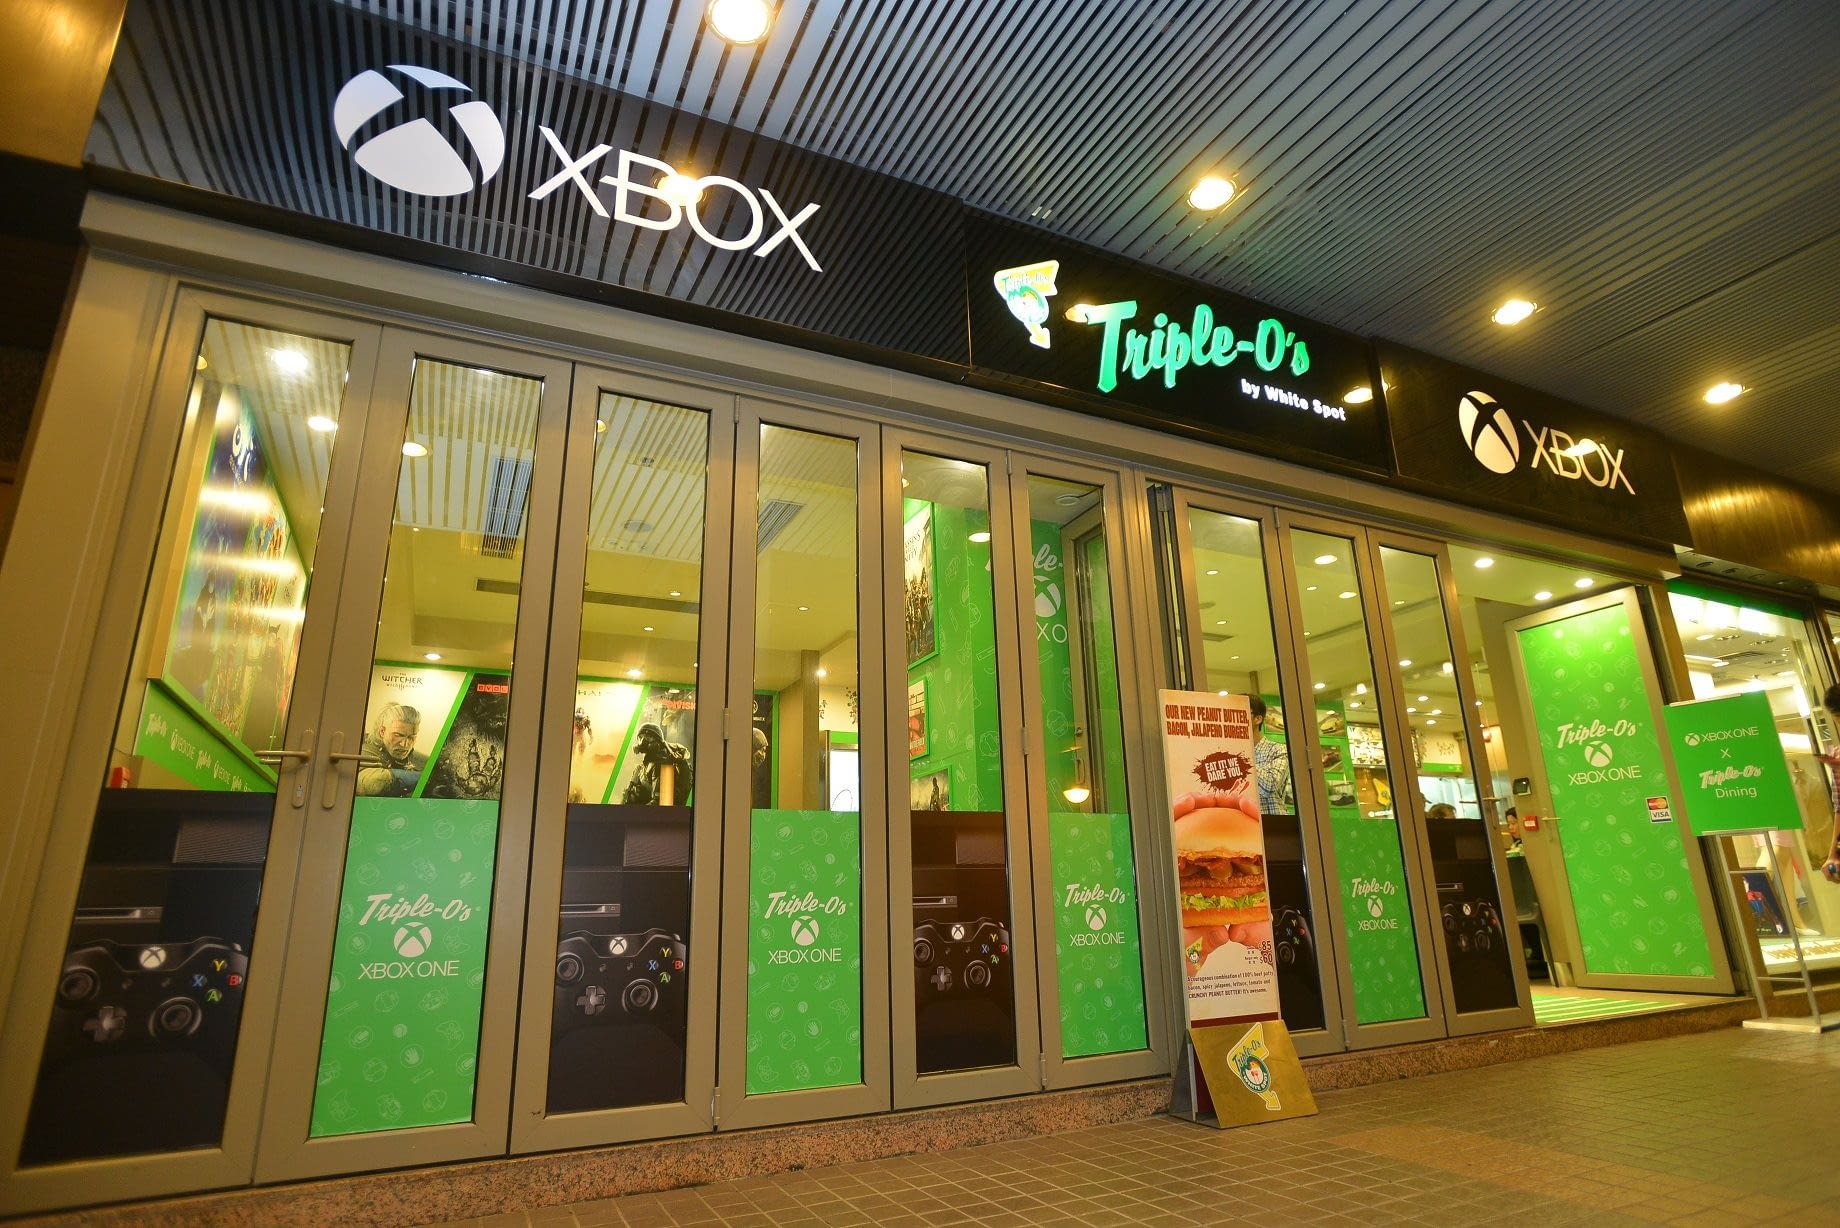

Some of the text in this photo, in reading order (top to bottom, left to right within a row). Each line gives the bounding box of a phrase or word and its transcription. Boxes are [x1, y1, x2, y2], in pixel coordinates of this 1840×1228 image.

[528, 124, 824, 273] XBOX
[1087, 301, 1310, 393] Triple-O's
[1241, 378, 1346, 421] by White Spot
[1522, 420, 1636, 495] XBOX
[381, 675, 423, 685] WITCHER
[1165, 704, 1179, 719] OUR
[1180, 705, 1195, 720] NEW
[1197, 706, 1222, 722] PEANUT
[1557, 719, 1636, 748] Triple-O's
[1205, 762, 1217, 771] EAT
[1227, 758, 1239, 767] WE
[1720, 748, 1732, 758] X
[1207, 766, 1243, 782] DARE YOU.
[1715, 787, 1757, 798] Dining
[1064, 883, 1126, 908] Triple-O's
[1351, 877, 1395, 898] Triple-O's
[359, 894, 472, 925] Triple-O's
[764, 892, 847, 919] Triple-O's
